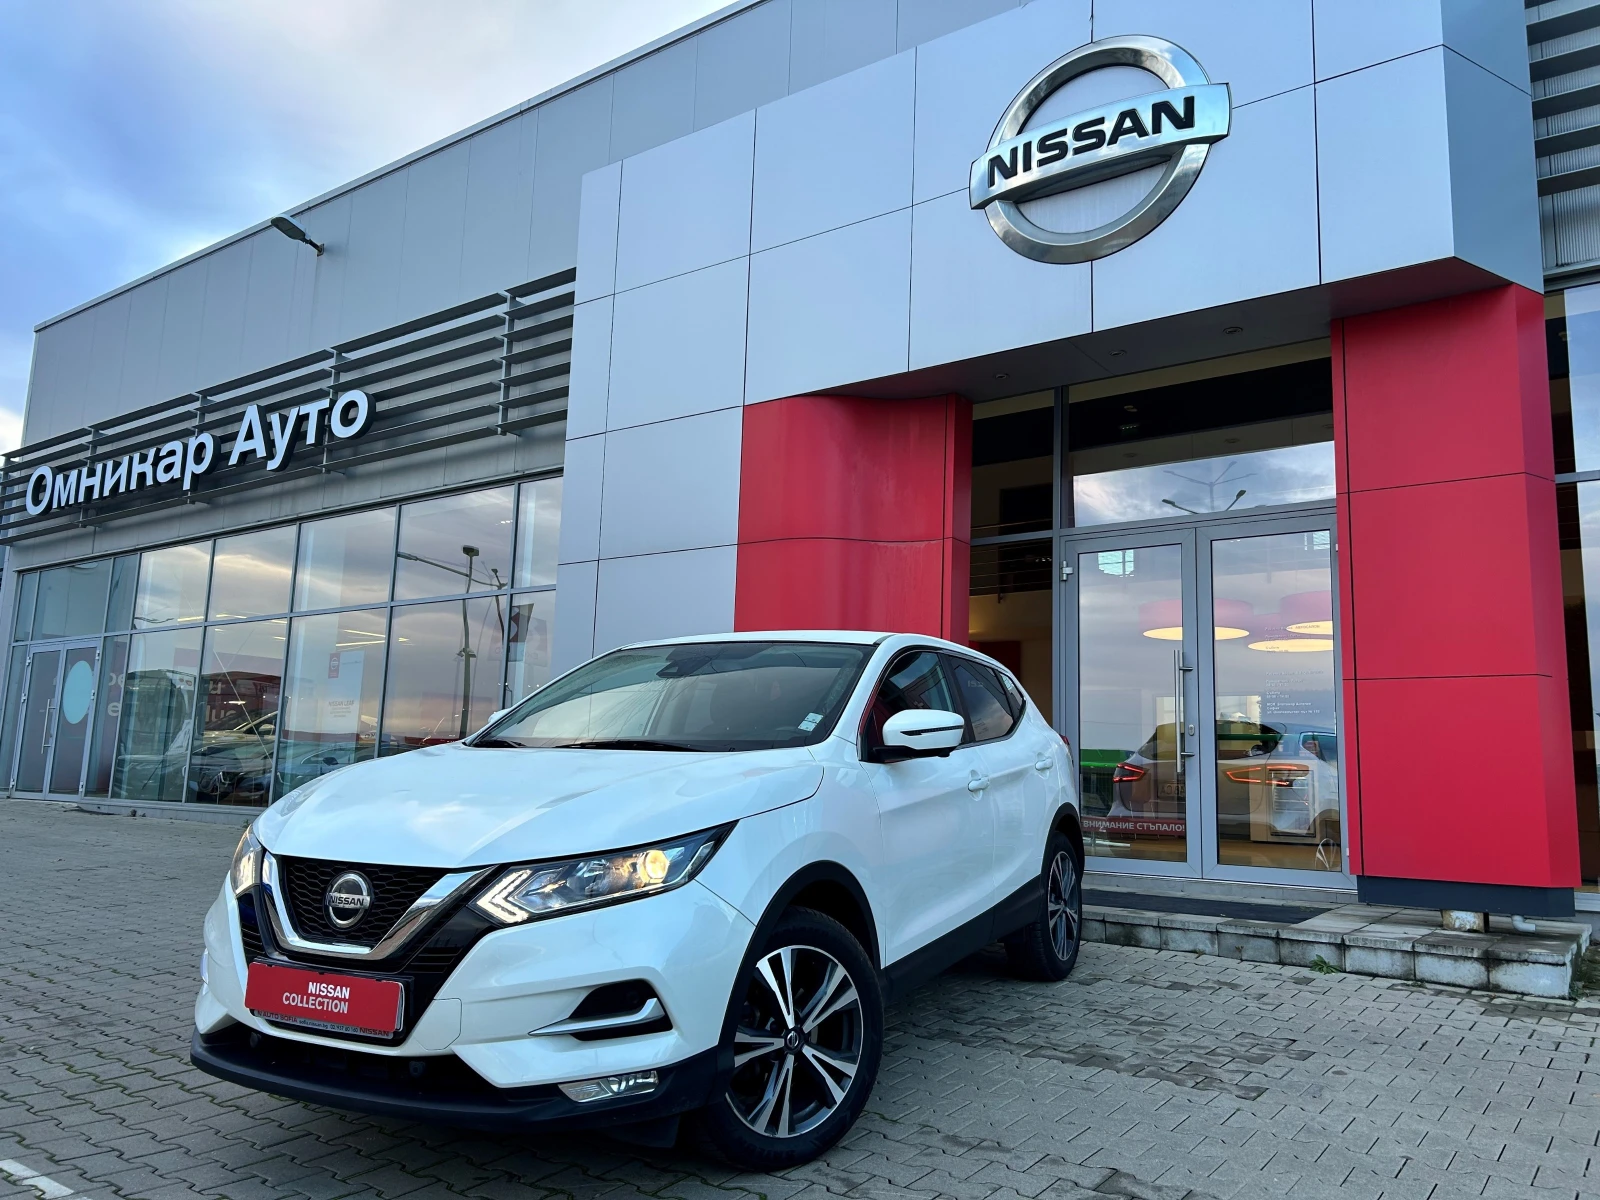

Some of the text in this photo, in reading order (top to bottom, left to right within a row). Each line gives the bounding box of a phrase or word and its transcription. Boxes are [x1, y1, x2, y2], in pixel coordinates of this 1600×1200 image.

[987, 95, 1196, 189] NISSAN
[26, 389, 370, 516] Омникар Ауто
[1083, 820, 1185, 832] ВНИМАНИЕ СТЪПАЛО!
[329, 896, 364, 906] NISSAN
[307, 982, 350, 999] NISSAN
[282, 992, 349, 1014] COLLECTION
[280, 1014, 298, 1023] SOFIA
[360, 1027, 389, 1037] NISSAN
